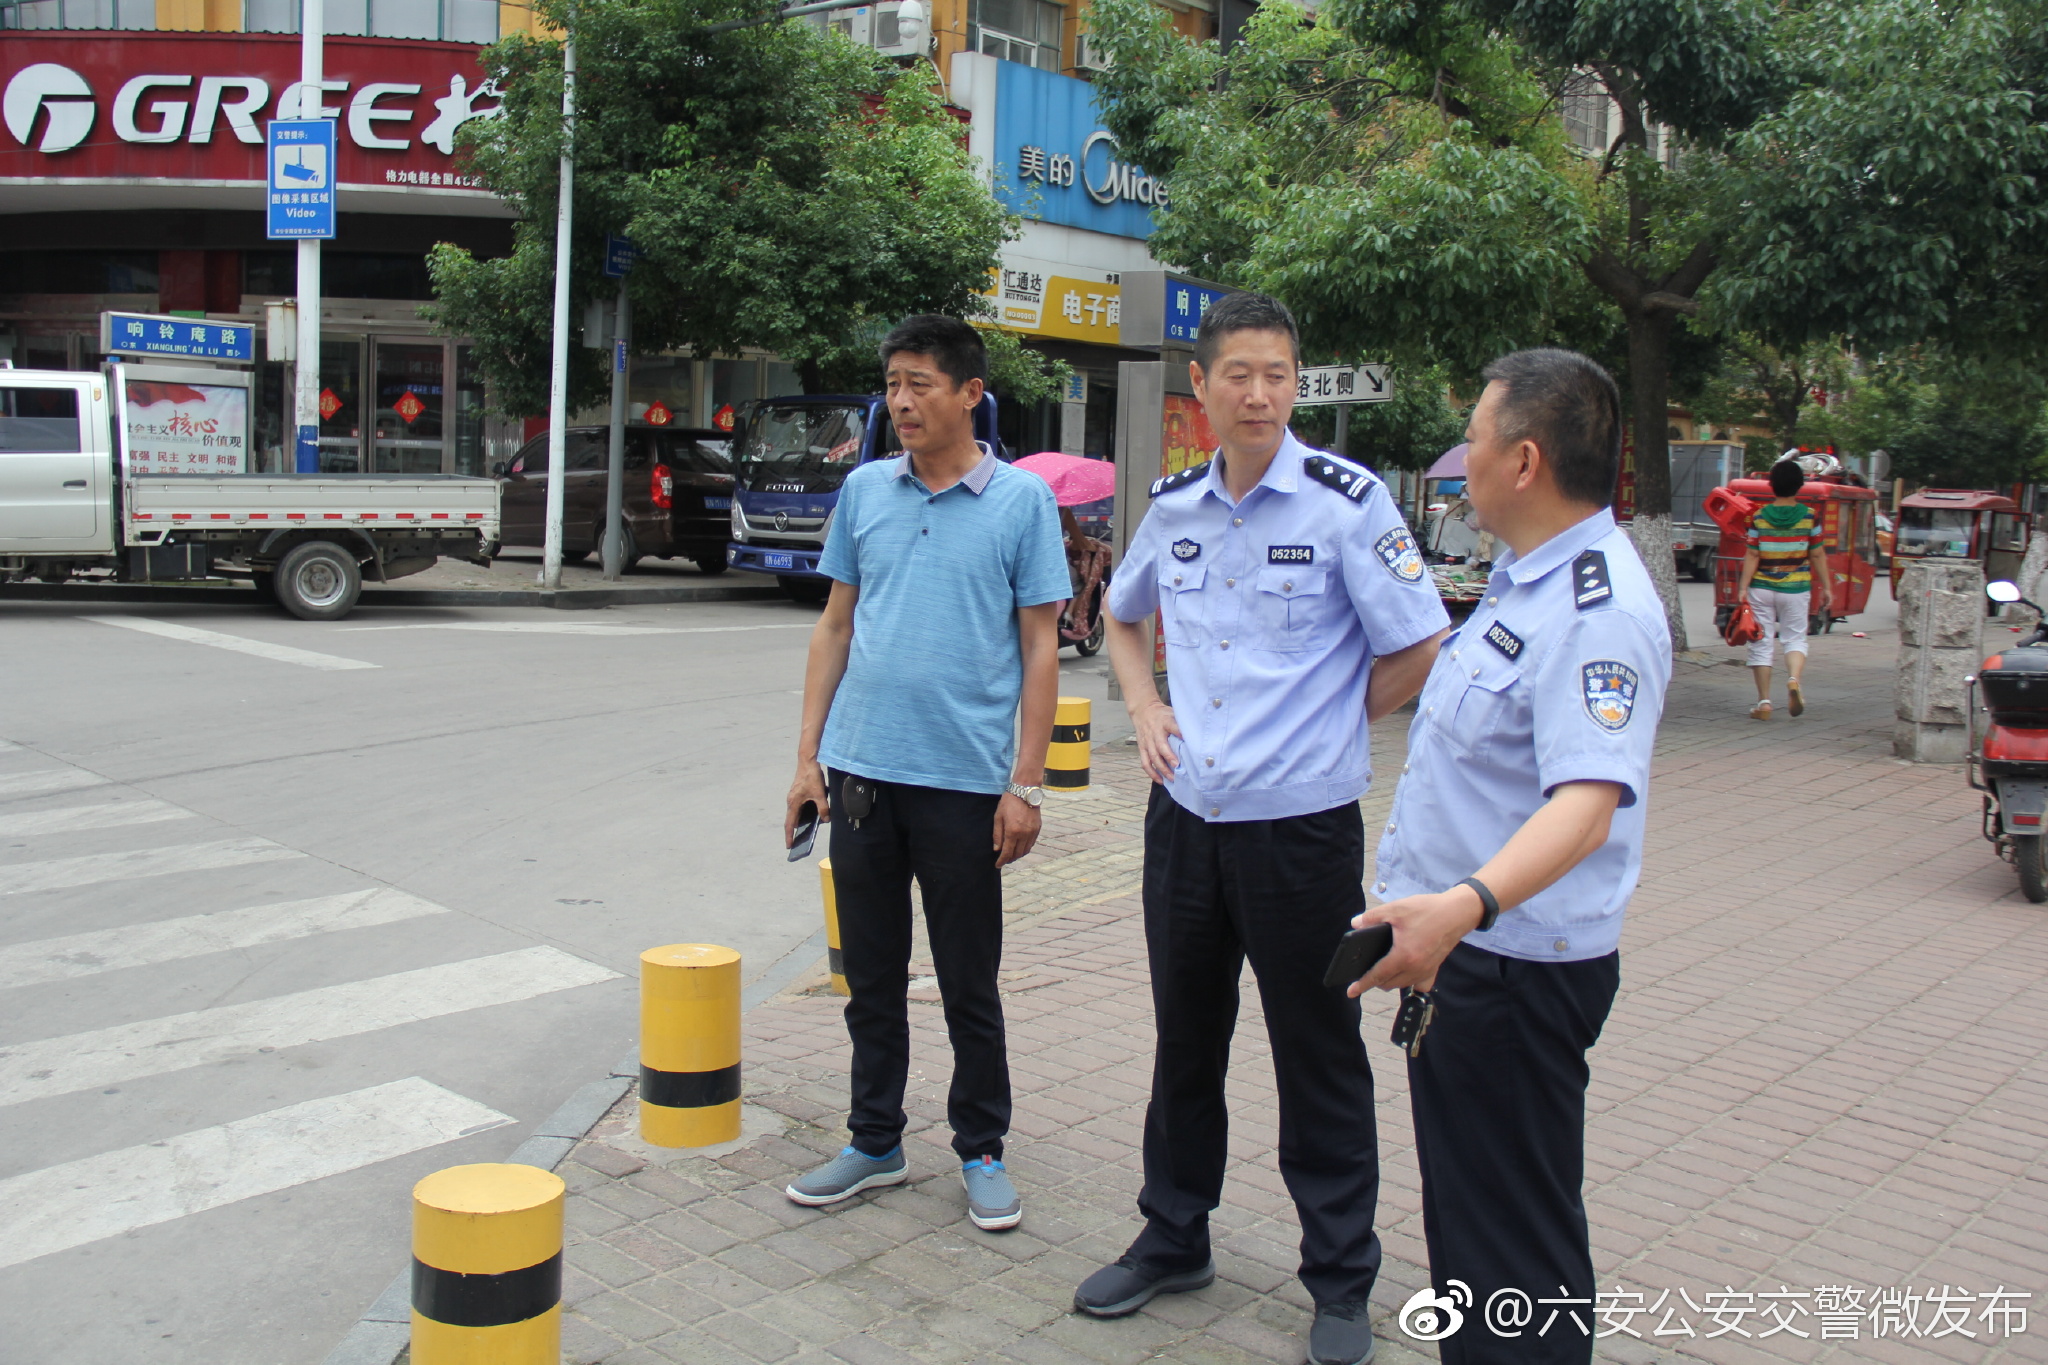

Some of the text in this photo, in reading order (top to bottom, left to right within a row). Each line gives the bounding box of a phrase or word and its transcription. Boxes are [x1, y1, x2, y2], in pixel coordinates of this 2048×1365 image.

[1018, 145, 1075, 187] 美的
[1081, 130, 1174, 207] Mide
[271, 192, 330, 205] 图像采集区域
[286, 207, 317, 218] Video
[1003, 268, 1042, 289] 汇通达
[127, 321, 237, 345] 响铃庵路
[129, 341, 137, 349] 东
[1068, 375, 1084, 399] 美
[320, 396, 335, 412] 福
[402, 399, 418, 415] 福
[168, 410, 219, 438] 核心
[652, 407, 668, 425] 福
[720, 409, 735, 428] 福
[202, 434, 242, 449] 价值观
[130, 450, 237, 466] 富强 民主 文明 和谐
[1271, 548, 1311, 560] 052354
[1488, 625, 1519, 655] 052303
